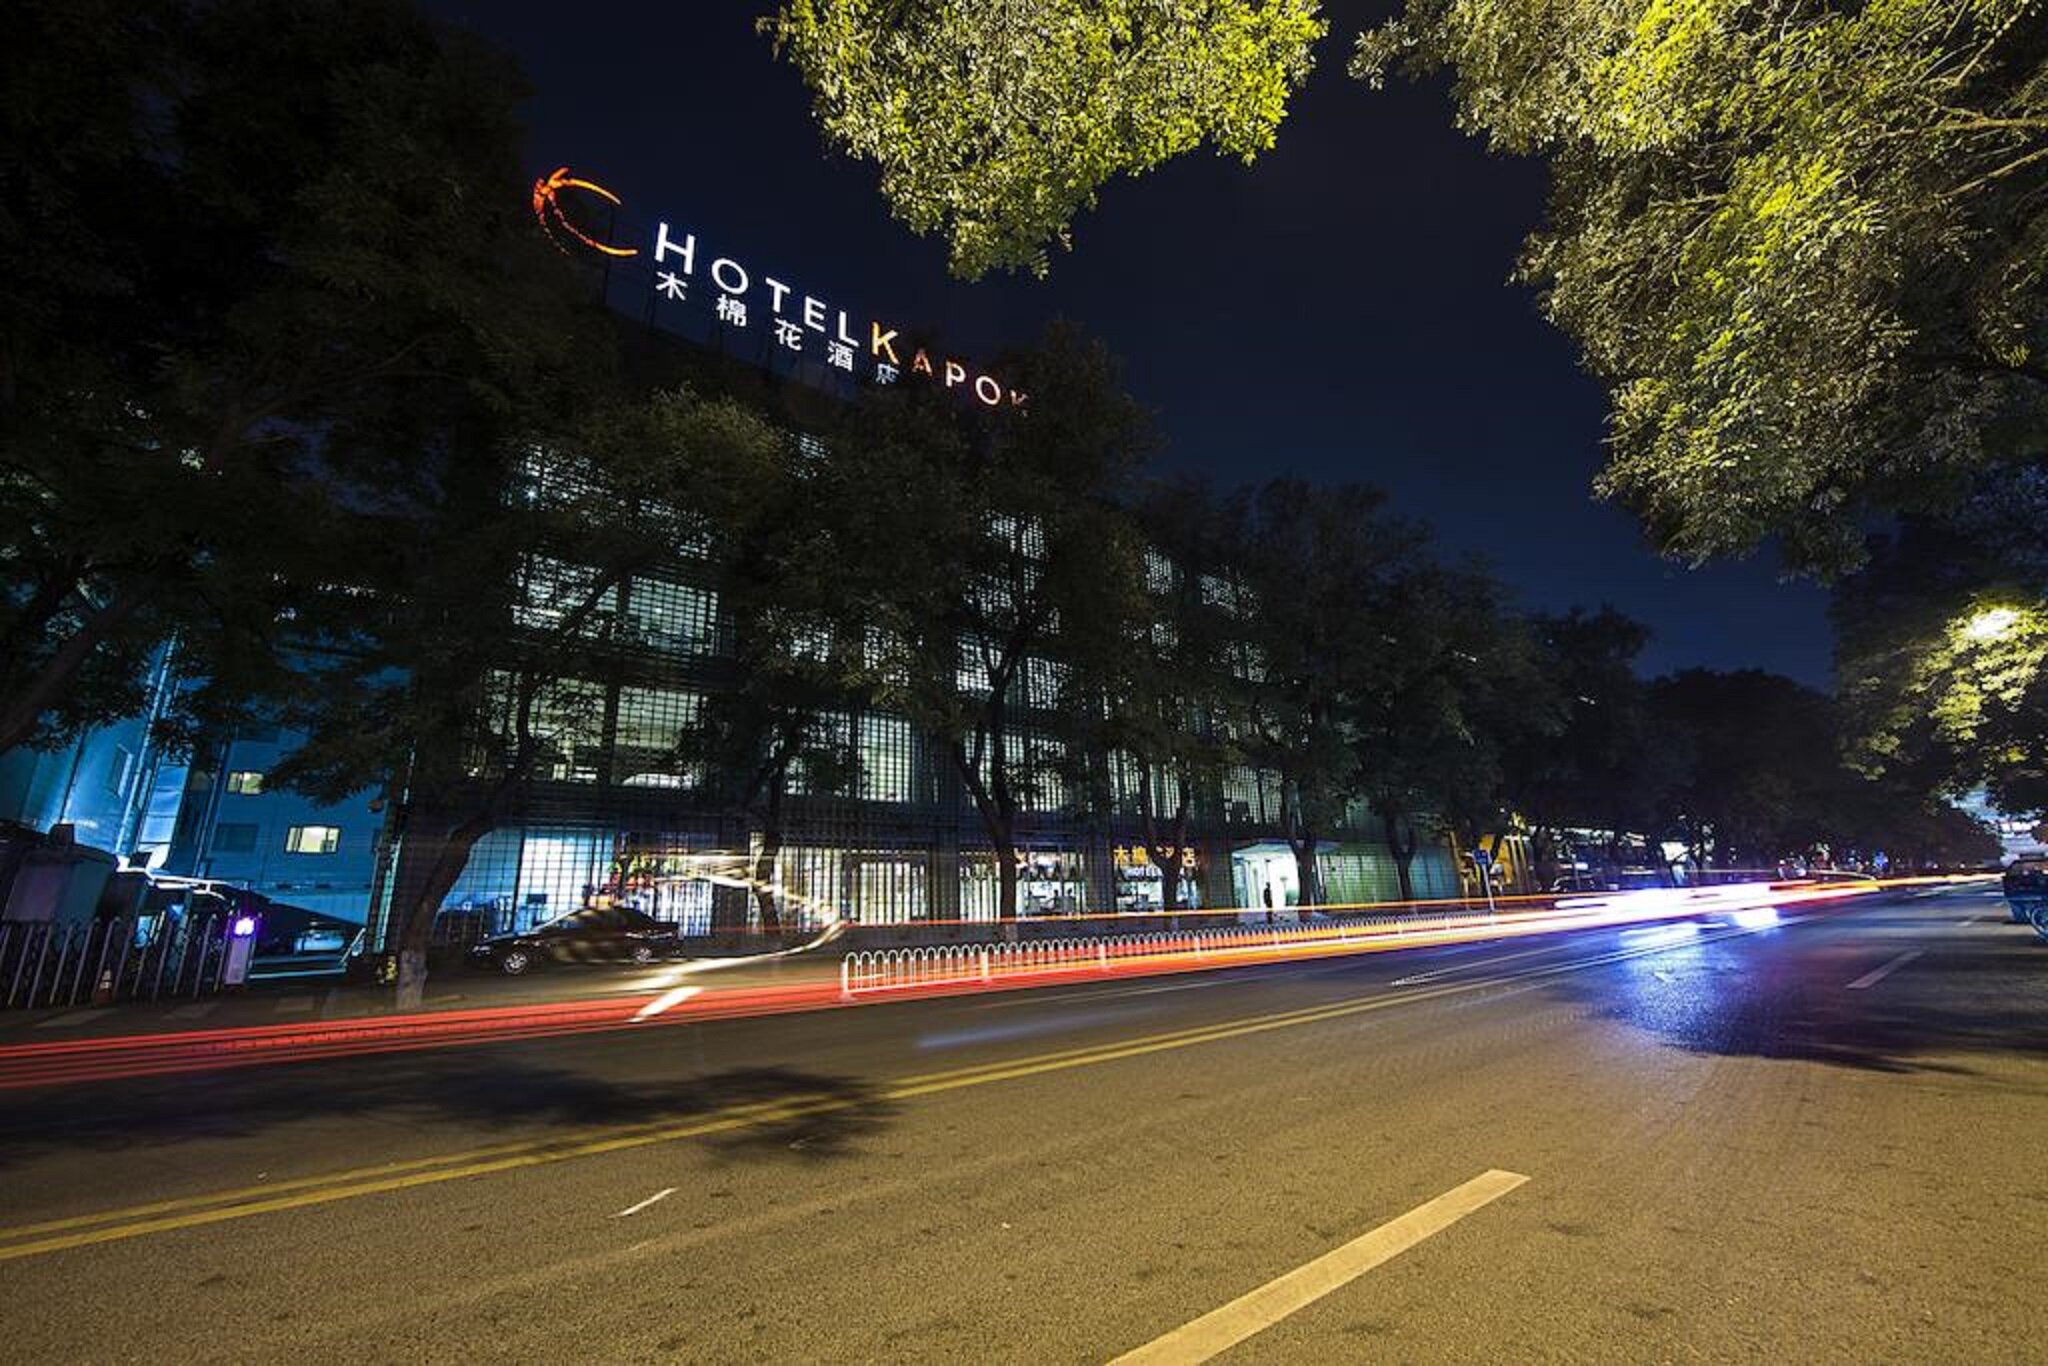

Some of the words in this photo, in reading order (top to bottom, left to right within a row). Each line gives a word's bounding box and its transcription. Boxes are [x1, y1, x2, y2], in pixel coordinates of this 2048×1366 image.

[655, 222, 859, 347] HOTEL
[656, 271, 899, 385] 木棉花酒店
